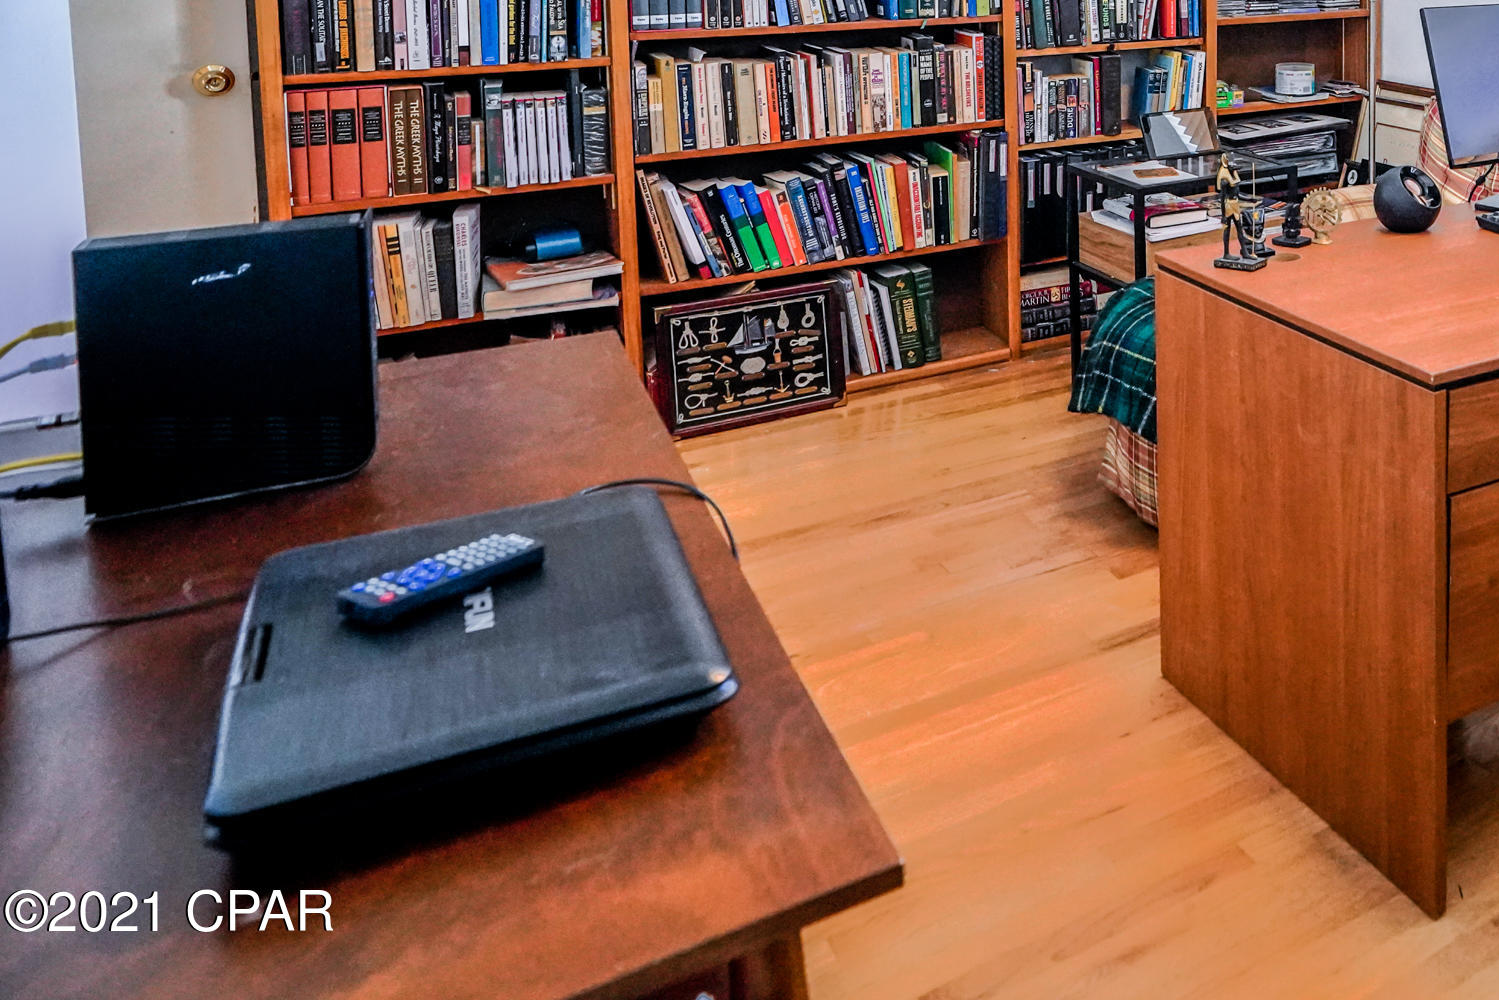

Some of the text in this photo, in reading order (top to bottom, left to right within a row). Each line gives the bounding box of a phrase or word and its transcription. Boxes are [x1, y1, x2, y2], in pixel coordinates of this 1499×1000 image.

[557, 19, 565, 30] SEA
[1066, 107, 1075, 129] DUNE
[393, 101, 407, 176] THE GREEK MYTHS
[409, 99, 423, 175] THE GREEK MYTHS
[639, 177, 648, 194] IMAGES
[646, 199, 657, 225] REVOLUTION
[798, 195, 814, 237] RECONSTRUCTION
[454, 223, 462, 247] BUKOWSKI
[459, 222, 467, 247] CHARLES
[732, 237, 741, 259] Ottoman
[736, 259, 745, 267] The
[1020, 295, 1050, 307] MARTIN
[902, 298, 918, 333] STEDMAN'S
